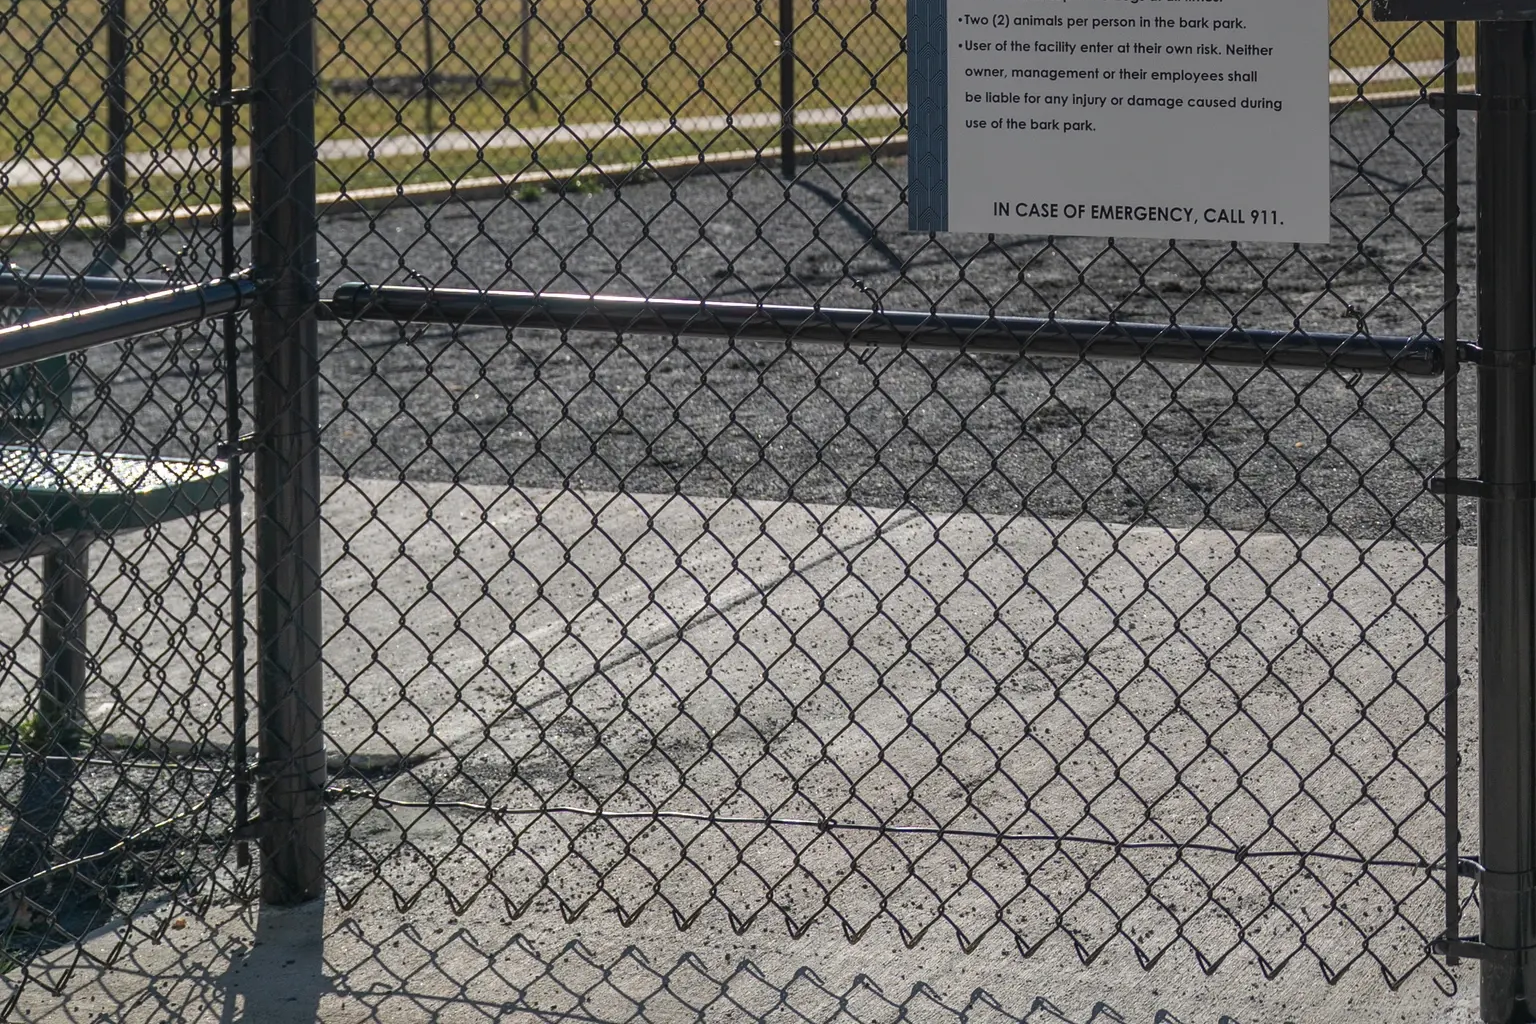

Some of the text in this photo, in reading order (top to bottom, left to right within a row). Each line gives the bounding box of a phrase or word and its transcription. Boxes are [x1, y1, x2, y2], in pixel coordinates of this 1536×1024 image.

[964, 14, 1246, 31] Two (2) animals per person in the bark park.
[965, 40, 1273, 56] User of the facility enter at their own risk. Neither
[965, 68, 1257, 84] owner, management or their employees shall
[965, 91, 1282, 112] be liable for any injury or damage caused during
[965, 118, 1096, 133] use of the bark park.
[994, 202, 1284, 225] IN CASE OF EMERGENCY, CALL 911.
